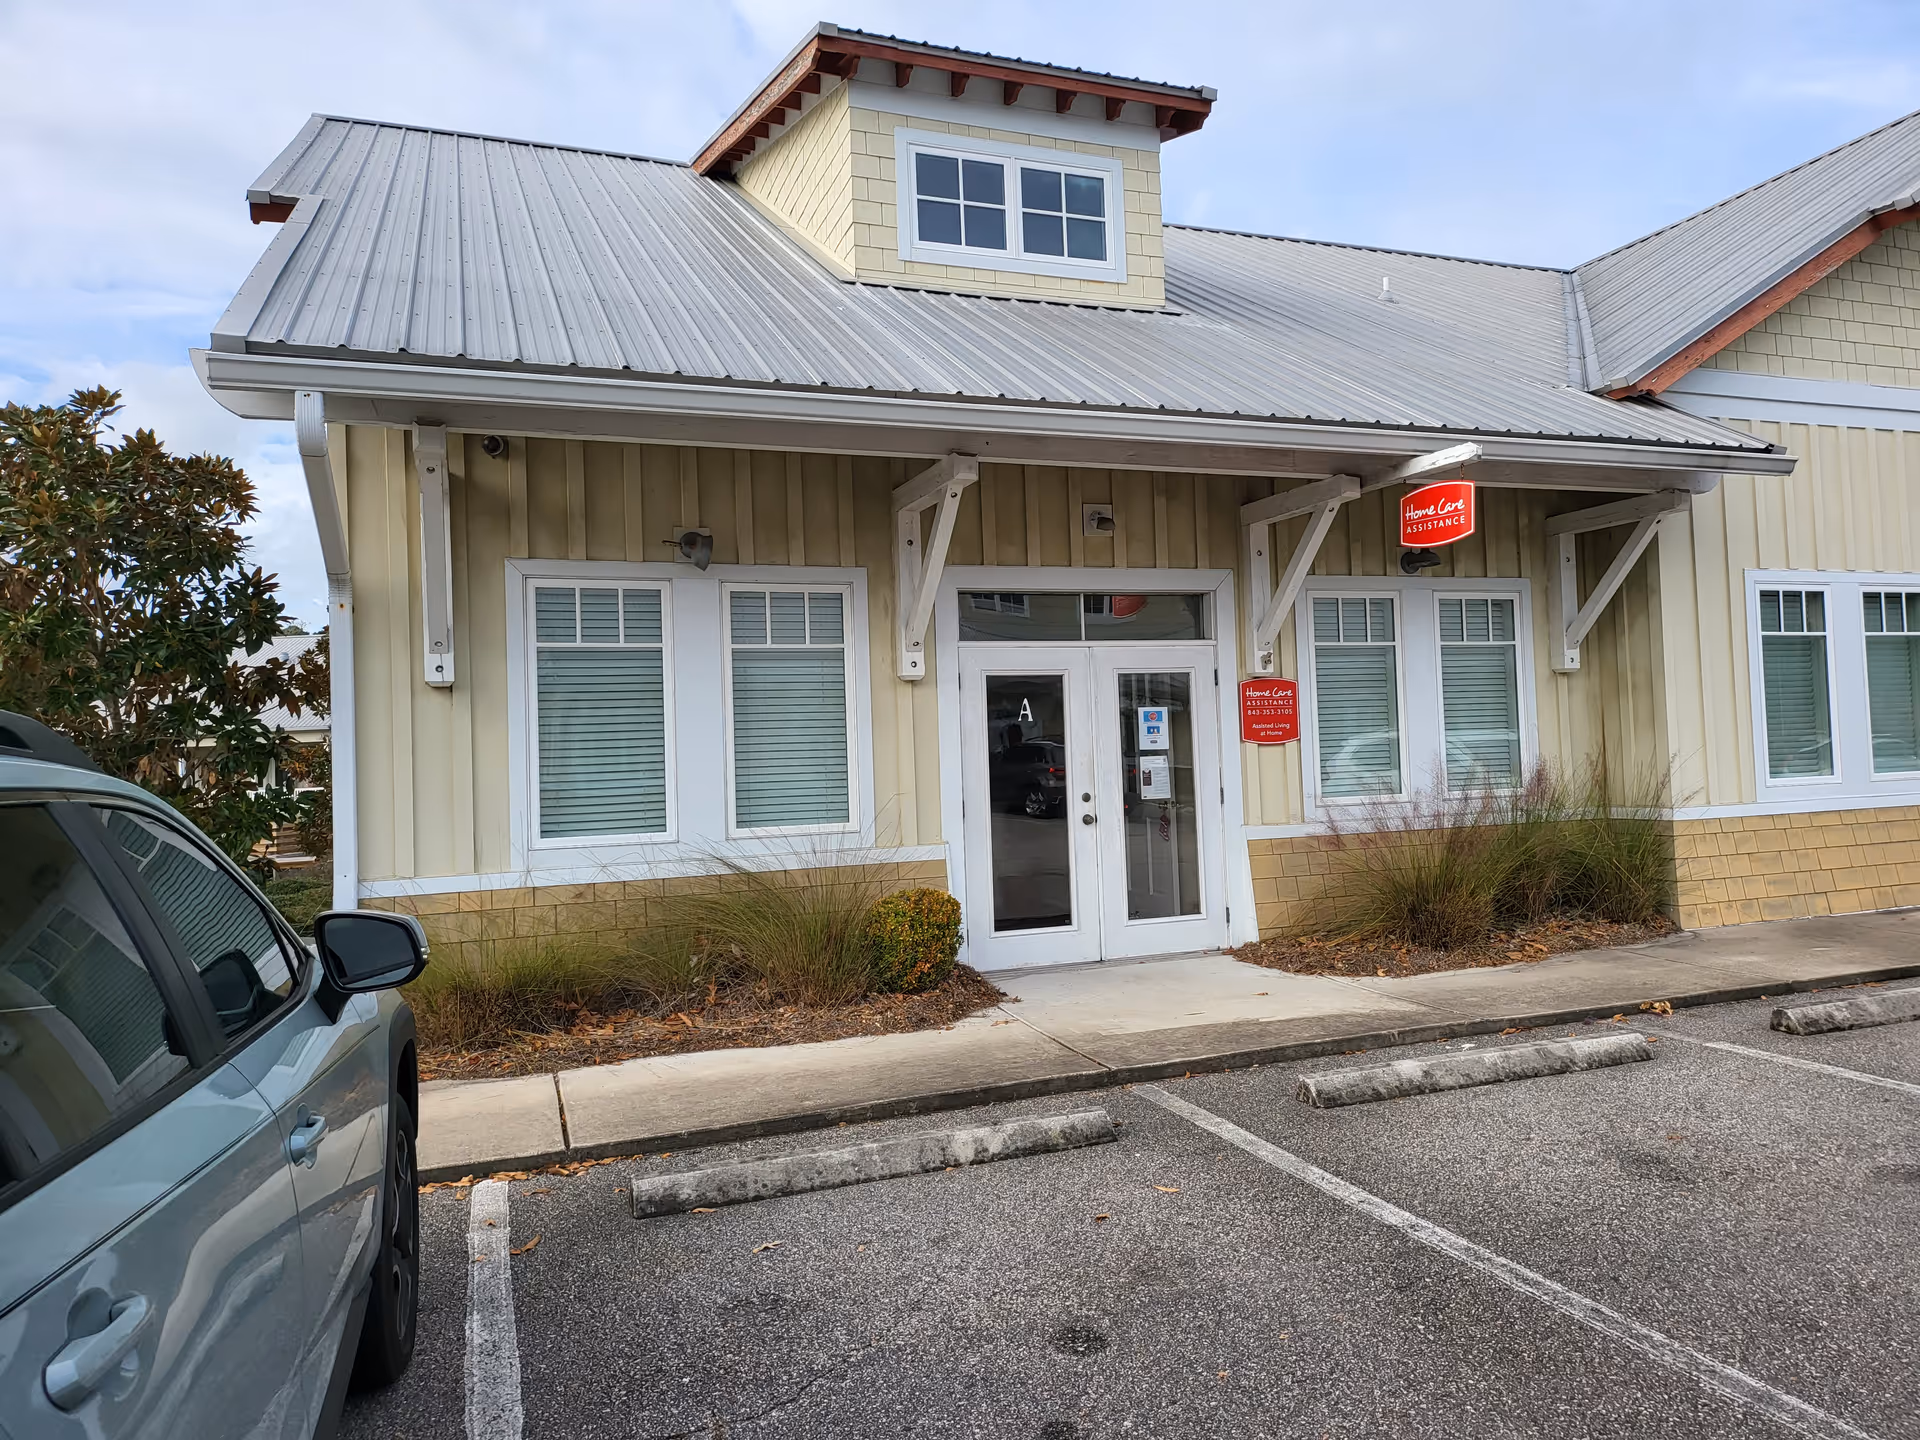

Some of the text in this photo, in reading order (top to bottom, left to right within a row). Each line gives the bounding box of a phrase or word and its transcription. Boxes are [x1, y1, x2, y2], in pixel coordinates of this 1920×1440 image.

[1405, 497, 1465, 520] Home Care
[1406, 515, 1465, 533] ASSISTANCE
[1246, 686, 1293, 697] Home Care
[1017, 697, 1033, 721] A
[1247, 708, 1293, 716] 843-353-3105
